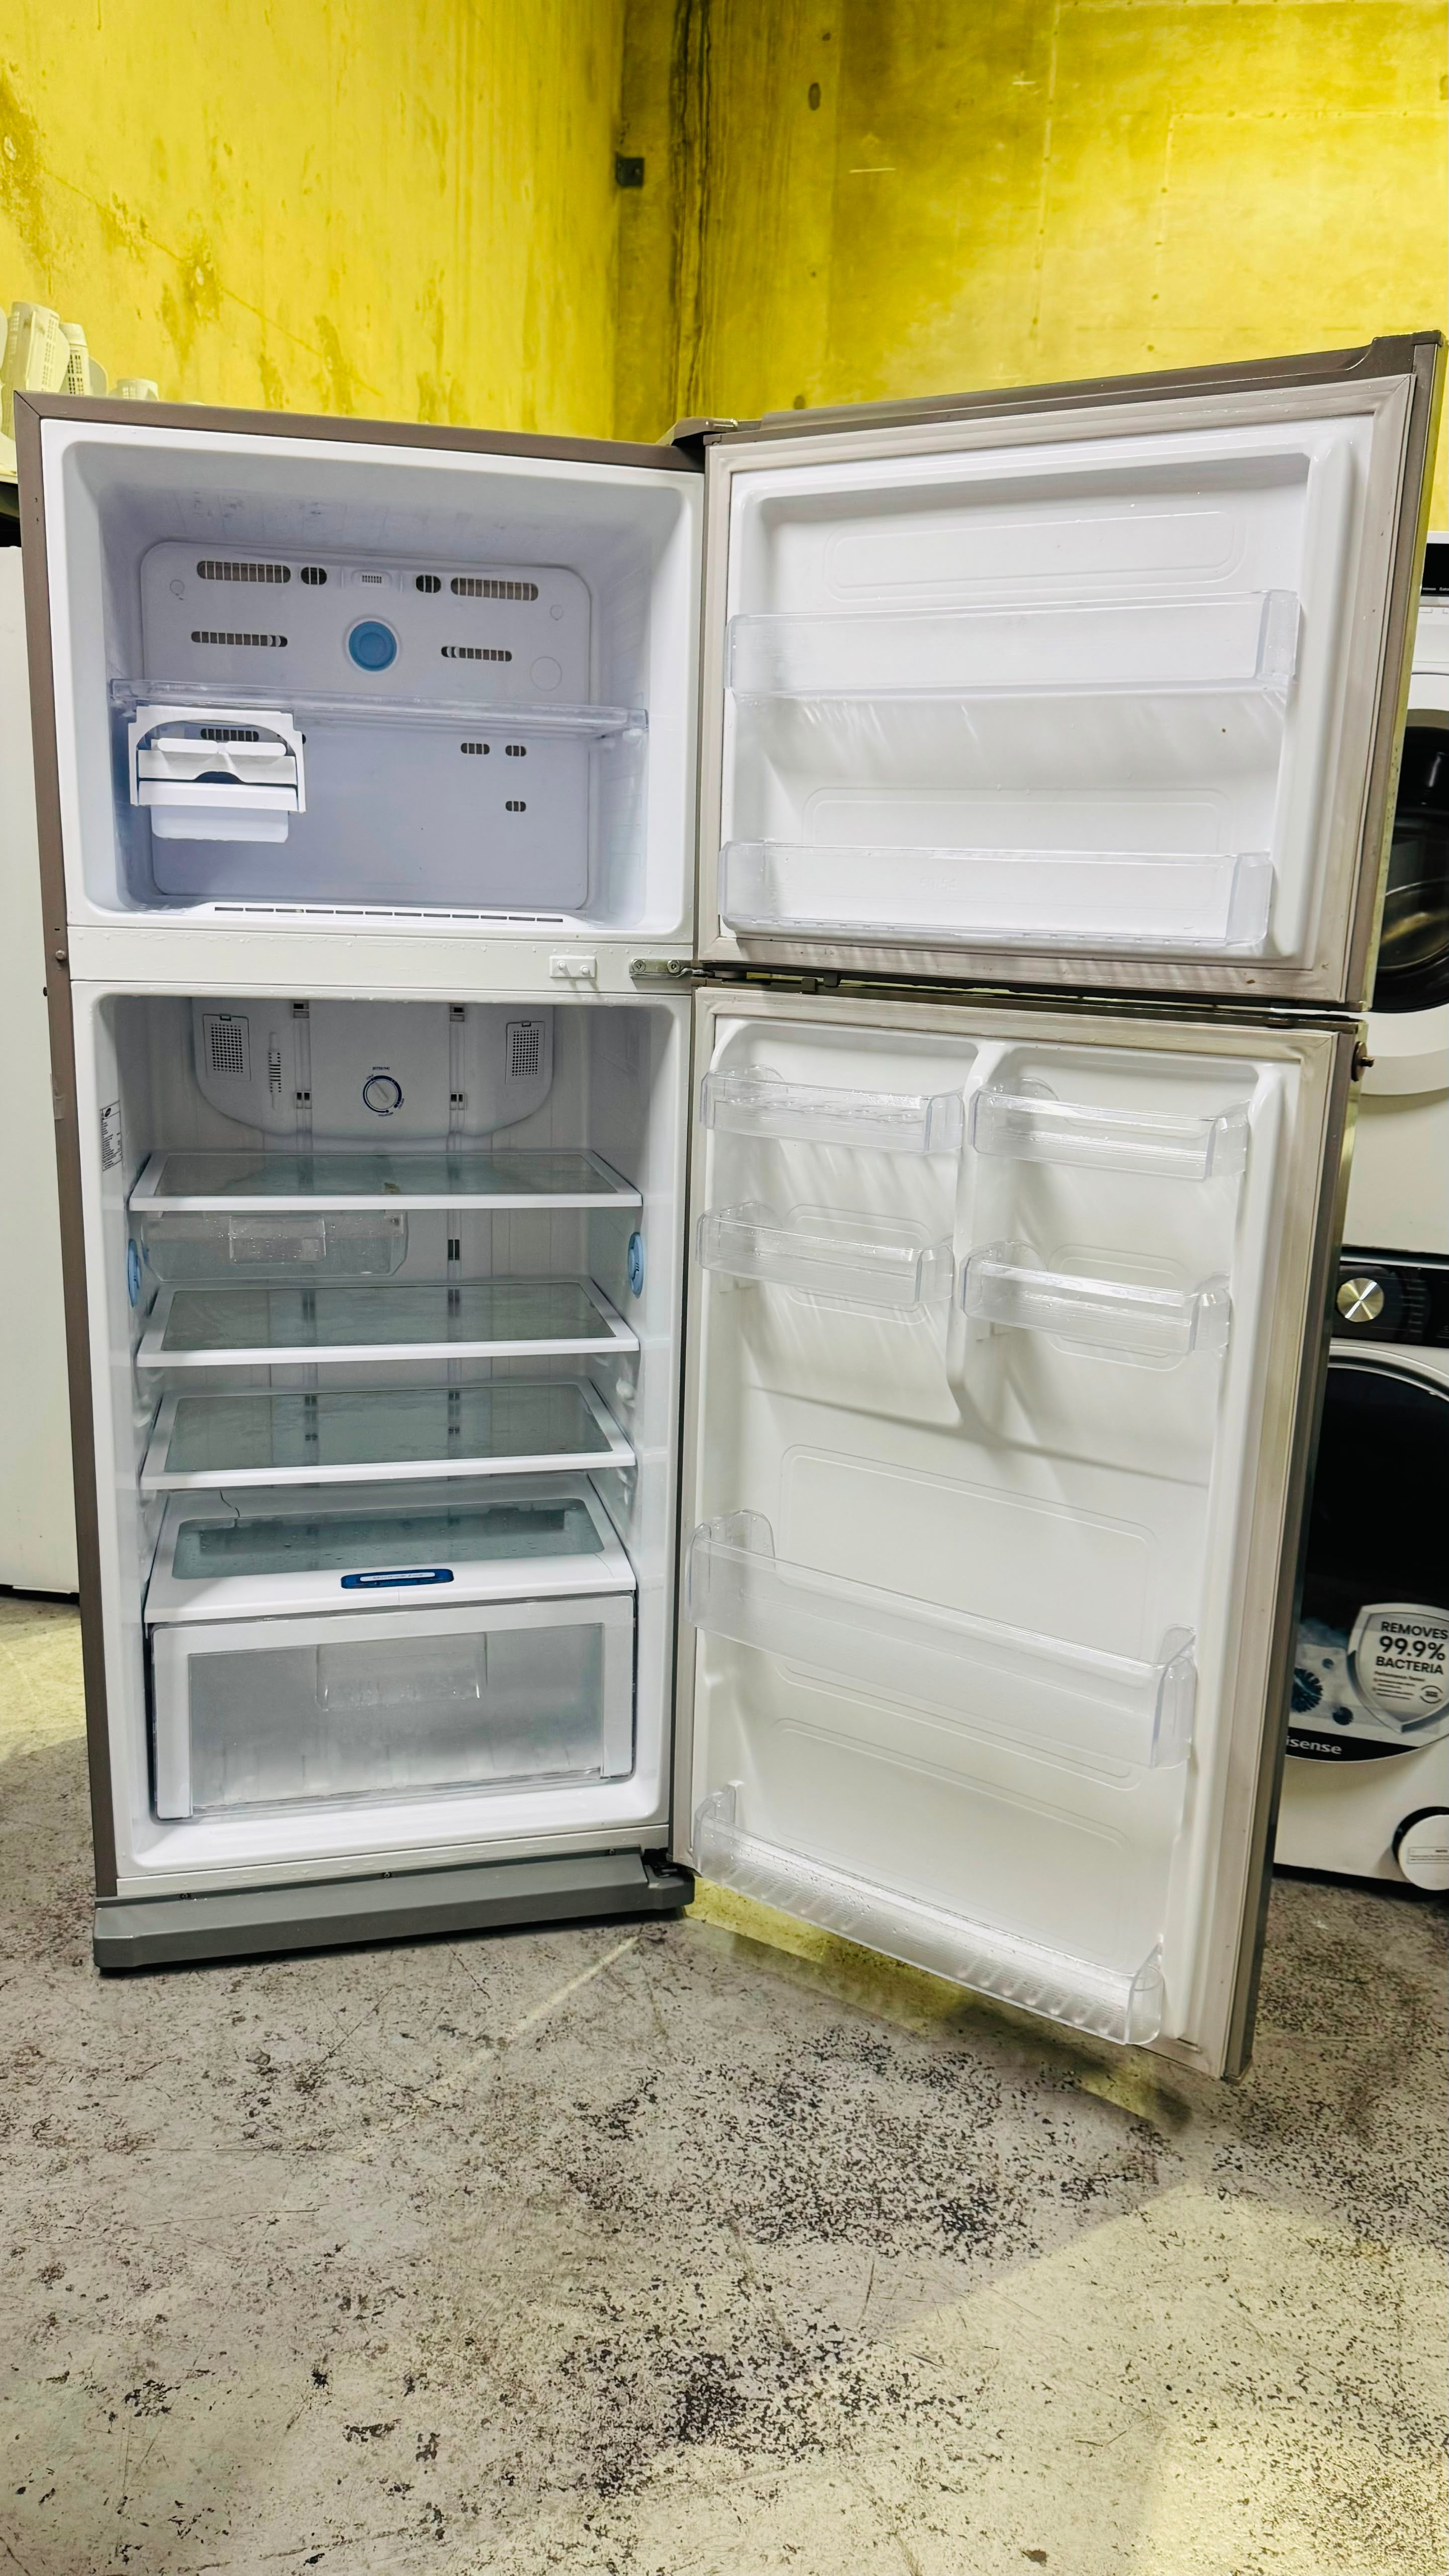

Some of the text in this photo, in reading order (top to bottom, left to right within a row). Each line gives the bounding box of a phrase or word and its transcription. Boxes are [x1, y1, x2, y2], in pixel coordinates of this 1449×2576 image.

[1382, 1622, 1448, 1640] REMOVES
[1380, 1635, 1446, 1661] 99.9%
[1376, 1656, 1444, 1675] BACTERIA
[1286, 1735, 1342, 1754] isense
